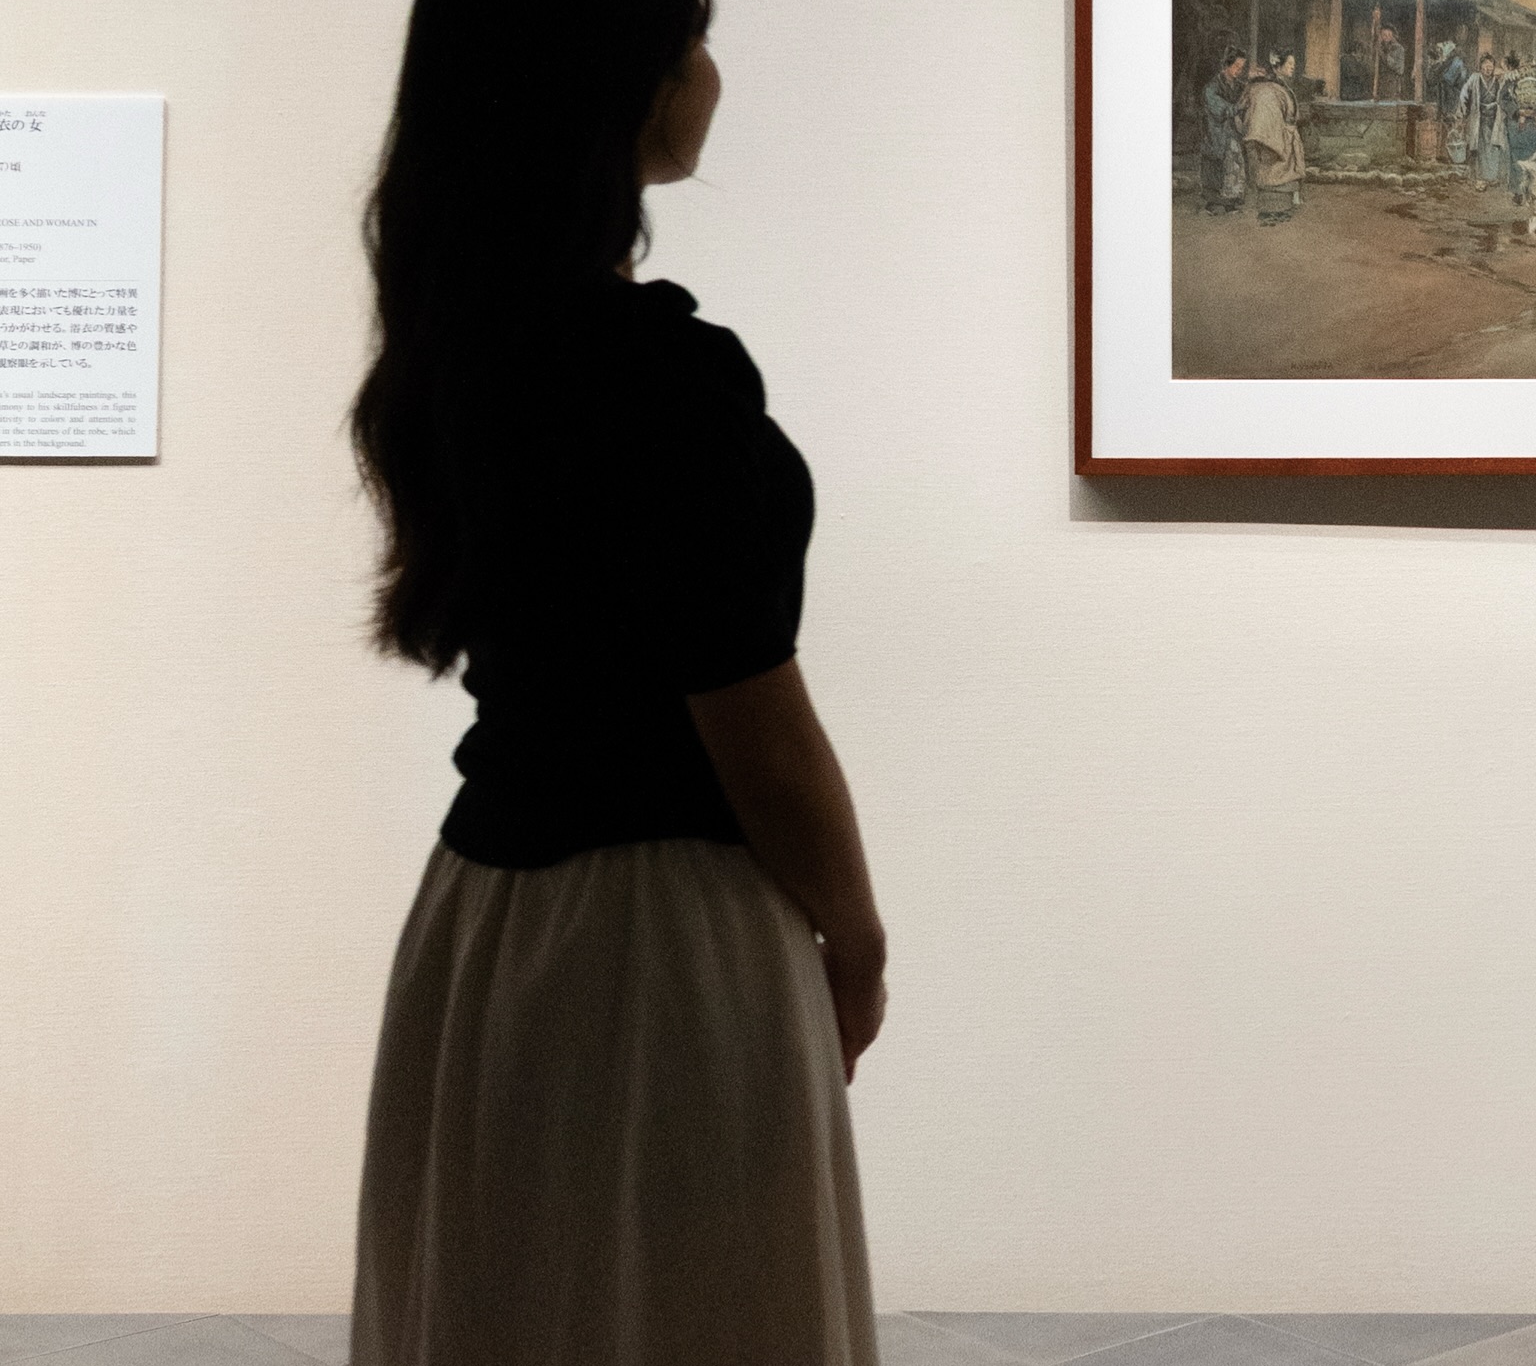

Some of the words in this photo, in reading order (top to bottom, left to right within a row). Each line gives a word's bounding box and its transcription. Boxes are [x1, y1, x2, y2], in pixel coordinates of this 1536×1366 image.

[22, 218, 44, 227] AND
[46, 218, 85, 227] WOMAN
[86, 218, 97, 227] IN
